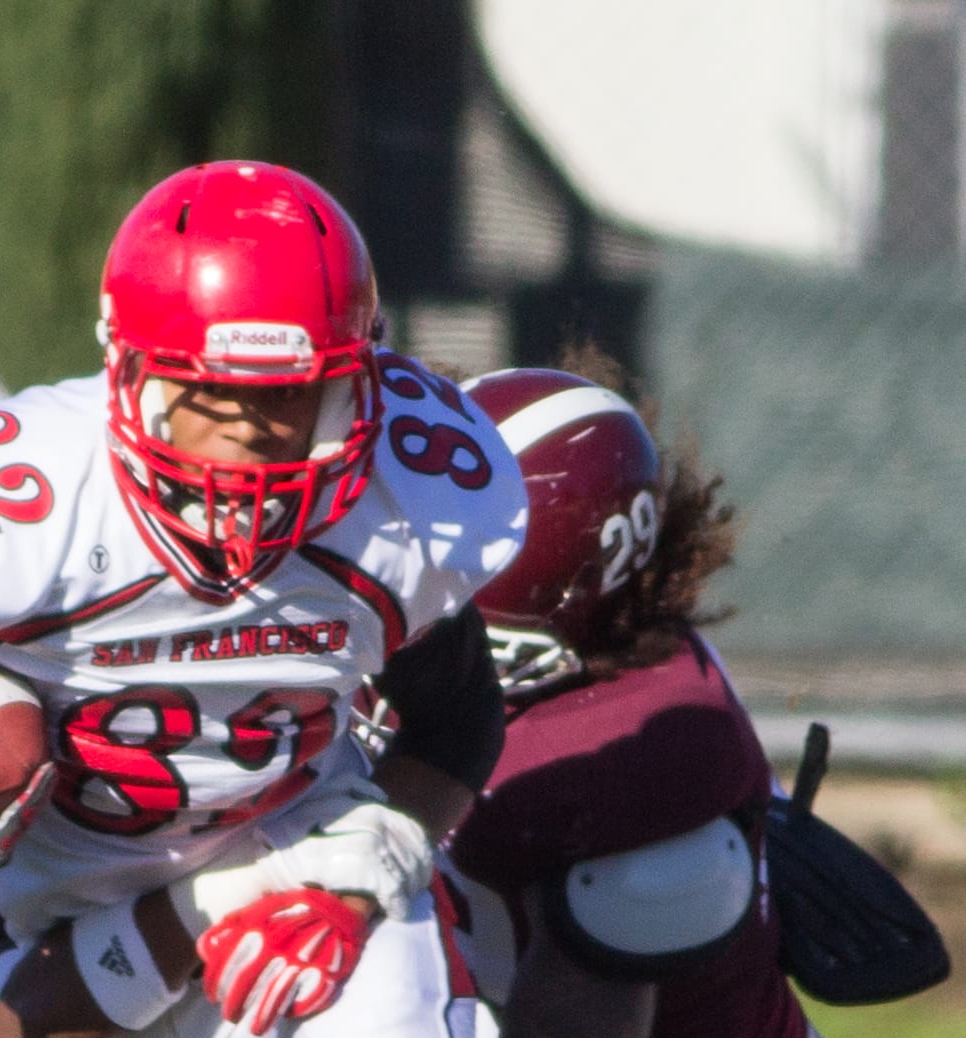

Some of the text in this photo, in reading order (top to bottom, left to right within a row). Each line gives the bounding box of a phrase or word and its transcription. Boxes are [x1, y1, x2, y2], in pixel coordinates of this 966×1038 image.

[230, 329, 289, 346] Riddell
[599, 488, 658, 595] 29
[90, 619, 350, 668] SAN FRANCISCO
[51, 683, 339, 836] 82
